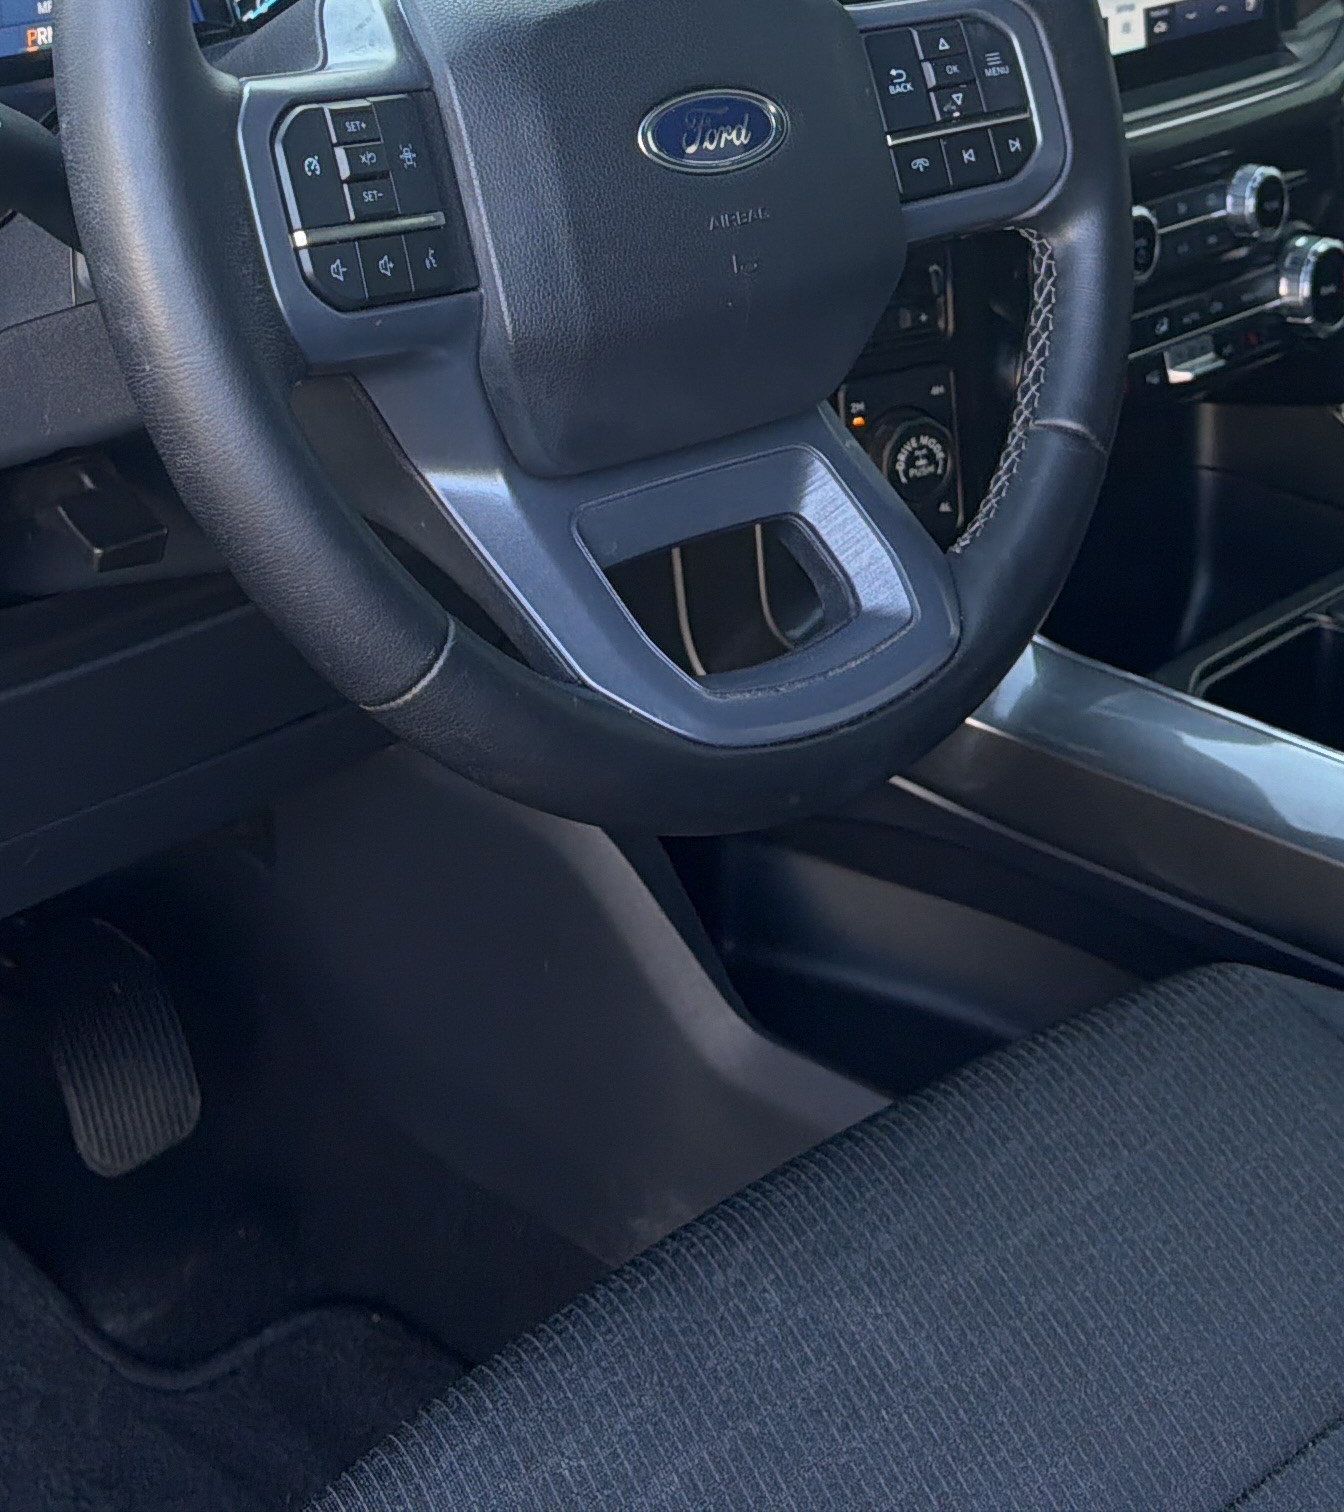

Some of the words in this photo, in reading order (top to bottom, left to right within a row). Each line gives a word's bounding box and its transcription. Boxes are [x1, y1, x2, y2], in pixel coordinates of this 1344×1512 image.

[945, 65, 960, 75] OK
[984, 65, 1010, 77] MENU
[888, 82, 914, 95] BACK
[345, 121, 367, 133] SET+
[682, 106, 751, 154] Ford
[709, 207, 771, 231] AIRBAG
